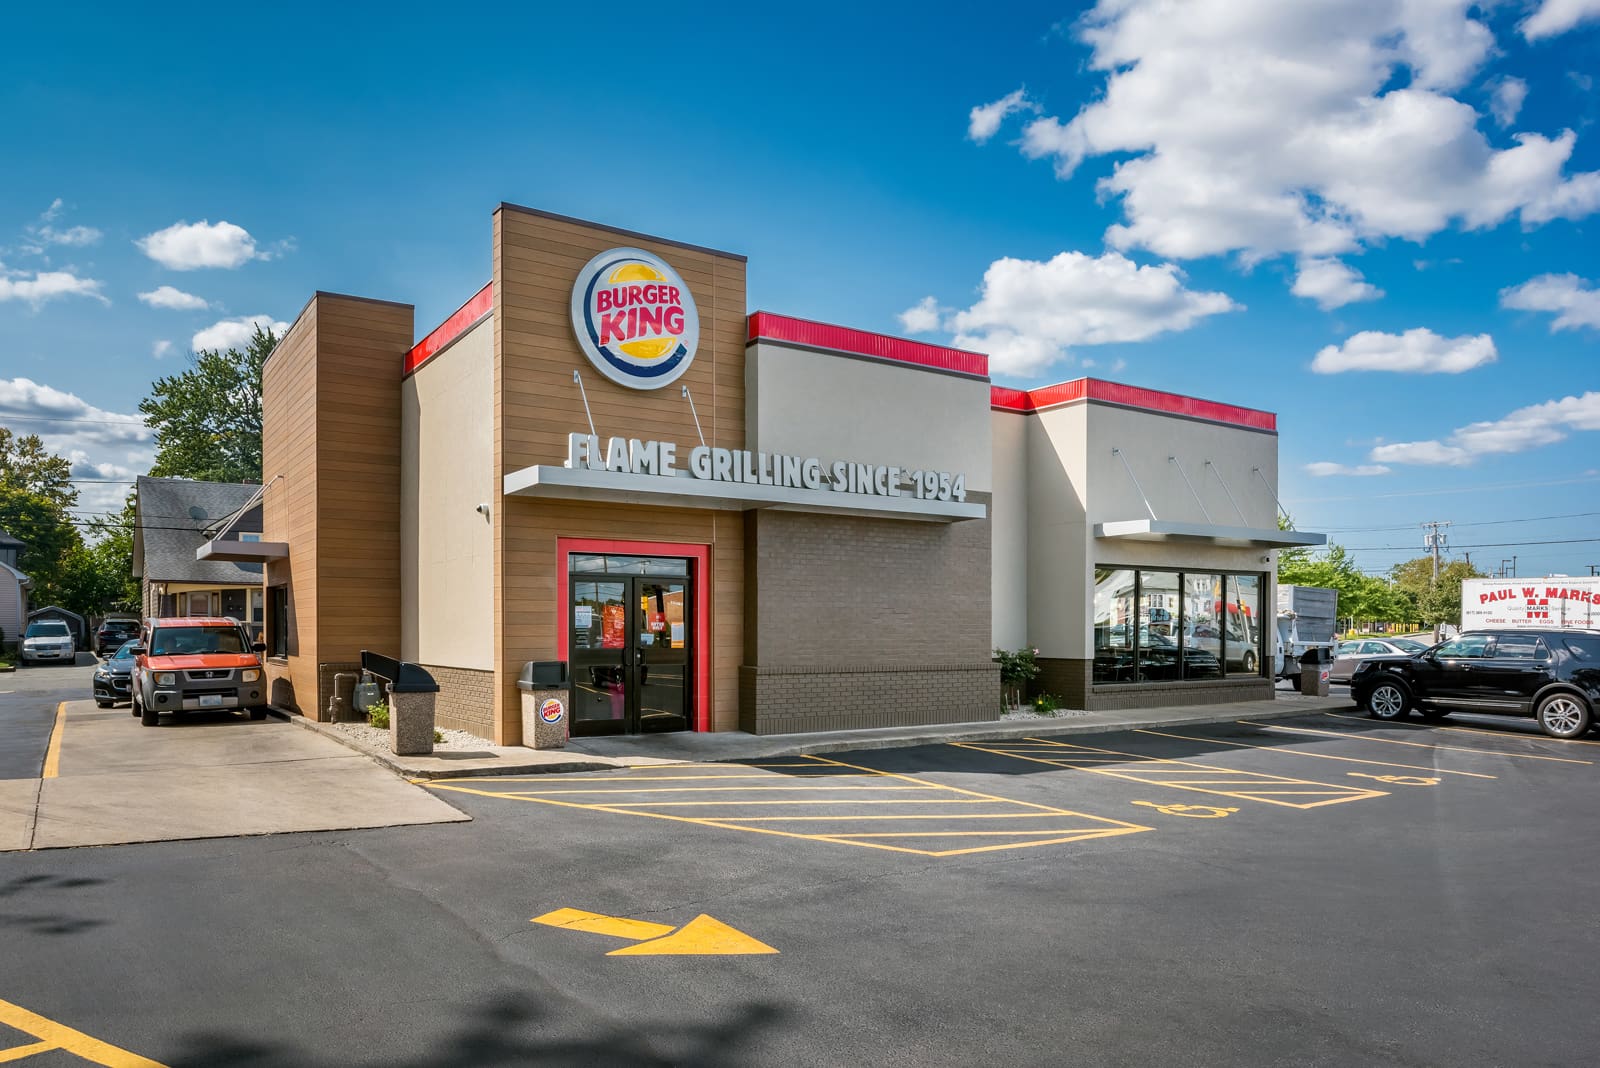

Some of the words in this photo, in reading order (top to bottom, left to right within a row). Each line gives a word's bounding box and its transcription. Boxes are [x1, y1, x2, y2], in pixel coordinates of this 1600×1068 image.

[597, 284, 681, 313] BURGER
[600, 306, 684, 346] KING
[565, 432, 676, 477] FLAME
[690, 446, 820, 490] GRILLING
[832, 460, 900, 496] SINCE
[912, 470, 966, 502] 1954
[1480, 589, 1516, 604] PAUL
[1522, 587, 1538, 598] W.
[1546, 587, 1600, 605] MARKS
[543, 707, 561, 718] KING
